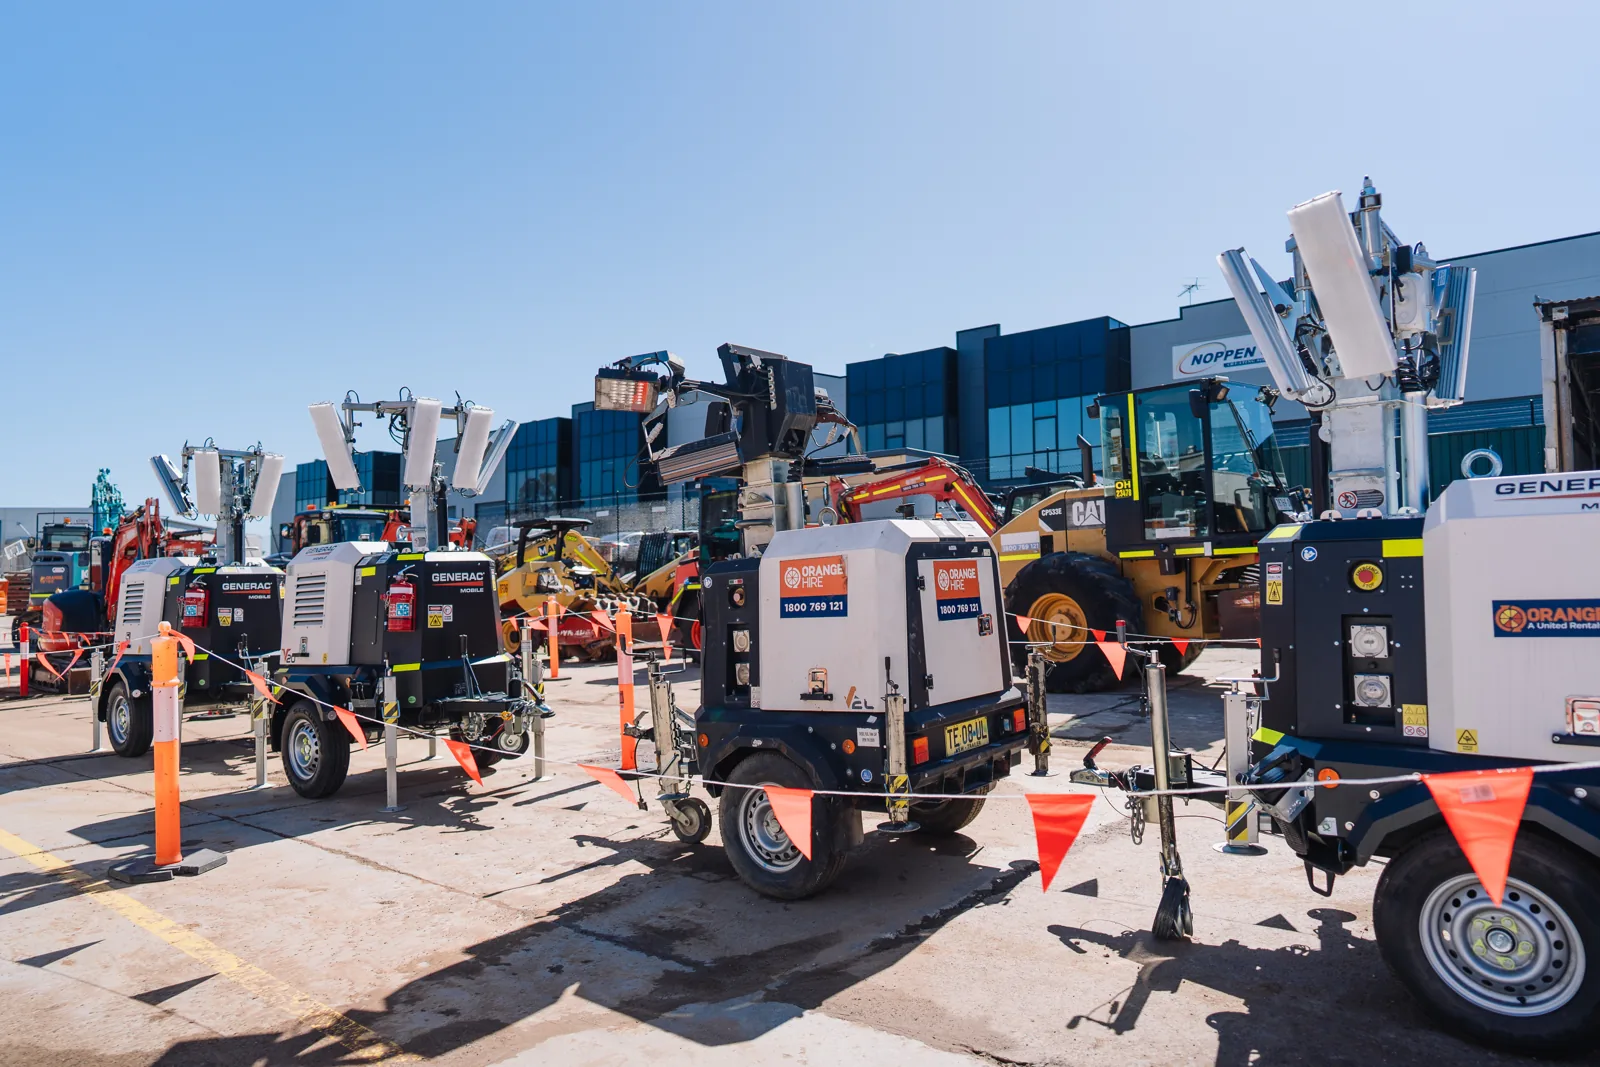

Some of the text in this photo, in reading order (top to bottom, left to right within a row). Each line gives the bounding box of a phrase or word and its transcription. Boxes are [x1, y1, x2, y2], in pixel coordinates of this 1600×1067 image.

[1191, 346, 1256, 366] NOPPEN
[1115, 480, 1131, 489] OH
[1041, 507, 1062, 517] CP533E
[1072, 499, 1105, 526] CAT
[801, 563, 844, 577] ORANGE
[949, 568, 976, 580] ORANGE
[432, 571, 484, 582] GENERAC
[801, 576, 824, 589] HIRE
[222, 582, 272, 590] GENERAC
[950, 579, 965, 591] HIRE
[784, 601, 843, 613] 1800 769 121
[940, 603, 979, 615] 1800 769 121
[1527, 621, 1600, 630] A United Rental
